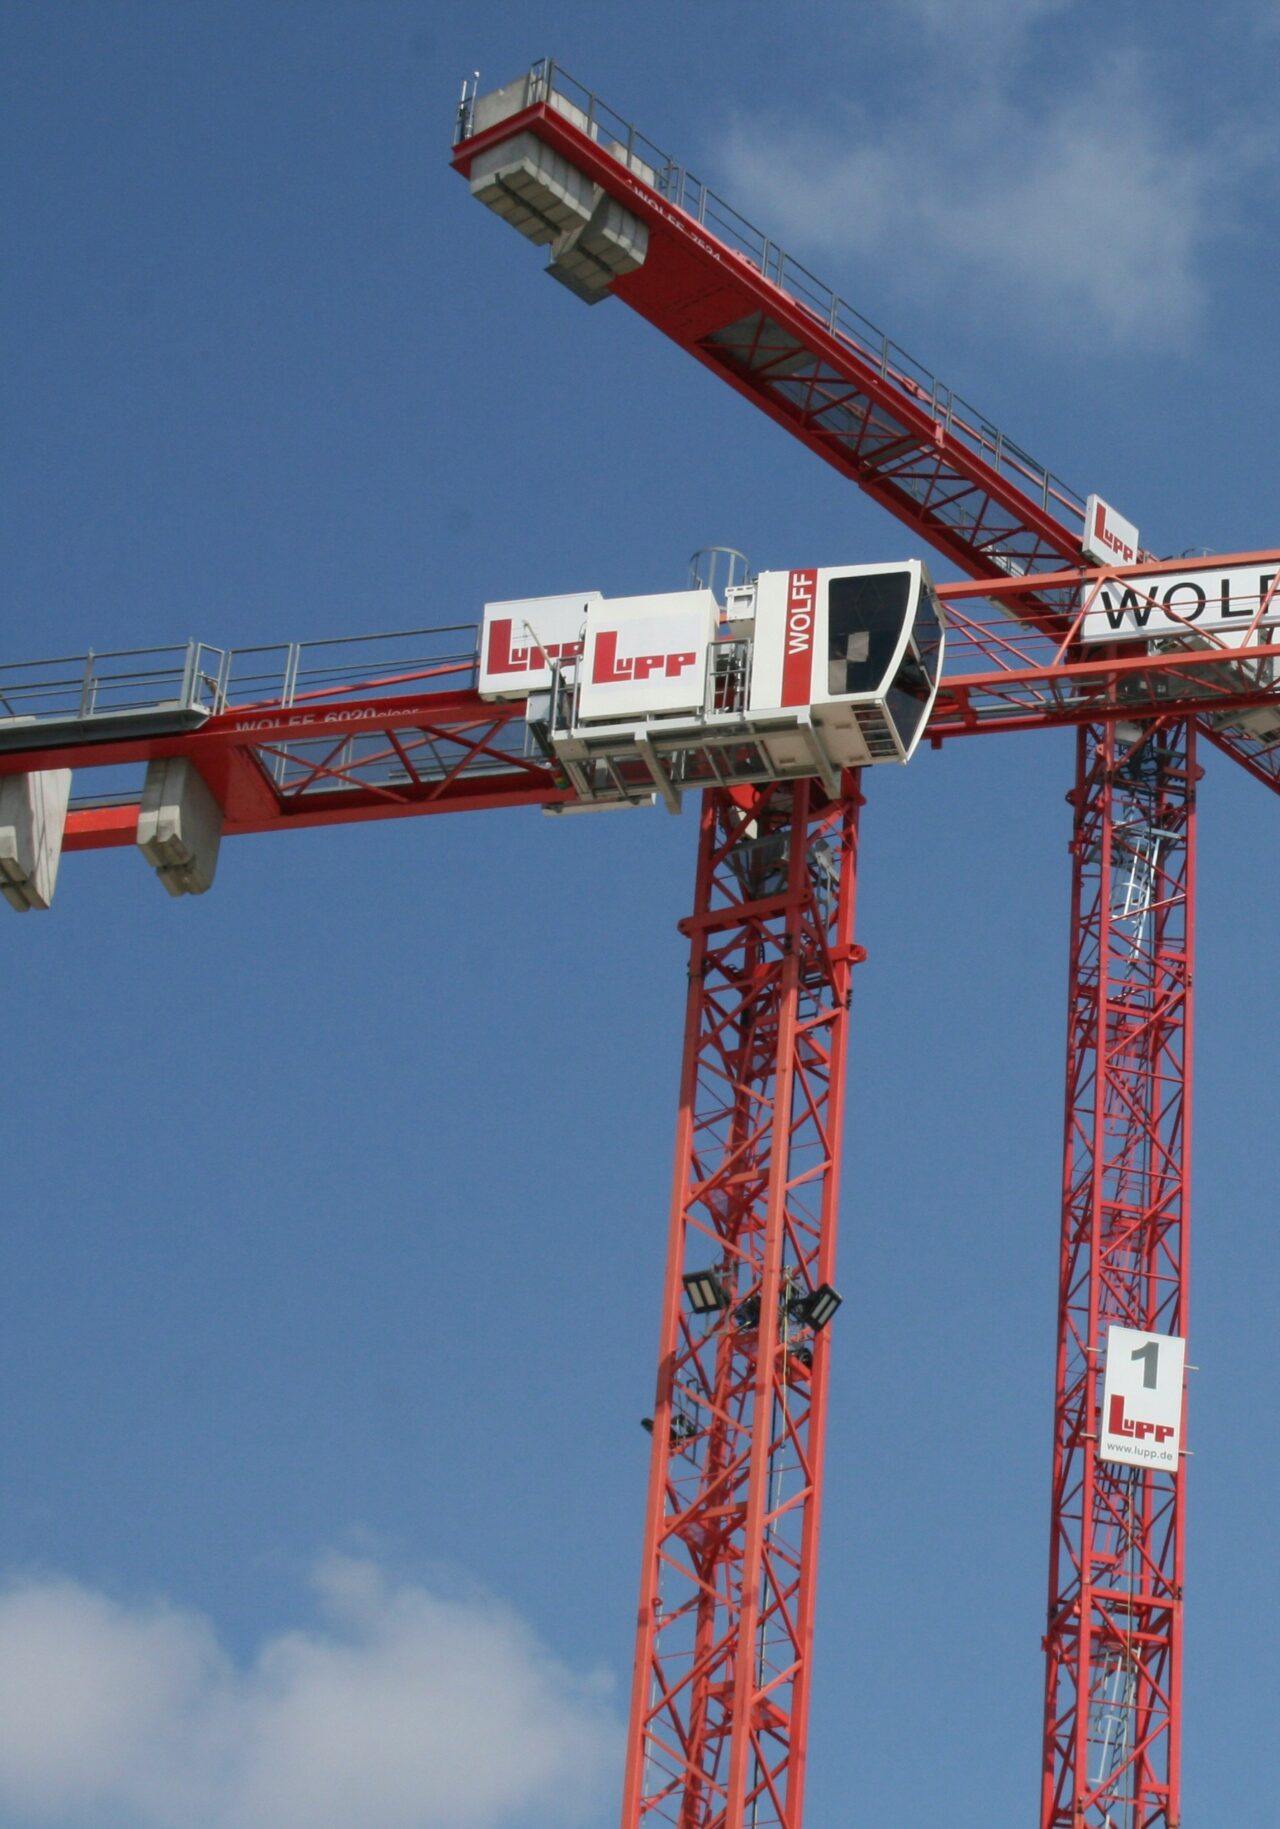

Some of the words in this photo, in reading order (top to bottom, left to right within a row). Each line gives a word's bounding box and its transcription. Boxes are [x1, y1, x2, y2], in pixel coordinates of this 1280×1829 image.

[789, 573, 813, 655] WOLFF
[1130, 1341, 1160, 1390] 1
[1107, 1443, 1173, 1460] www.lupp.de
